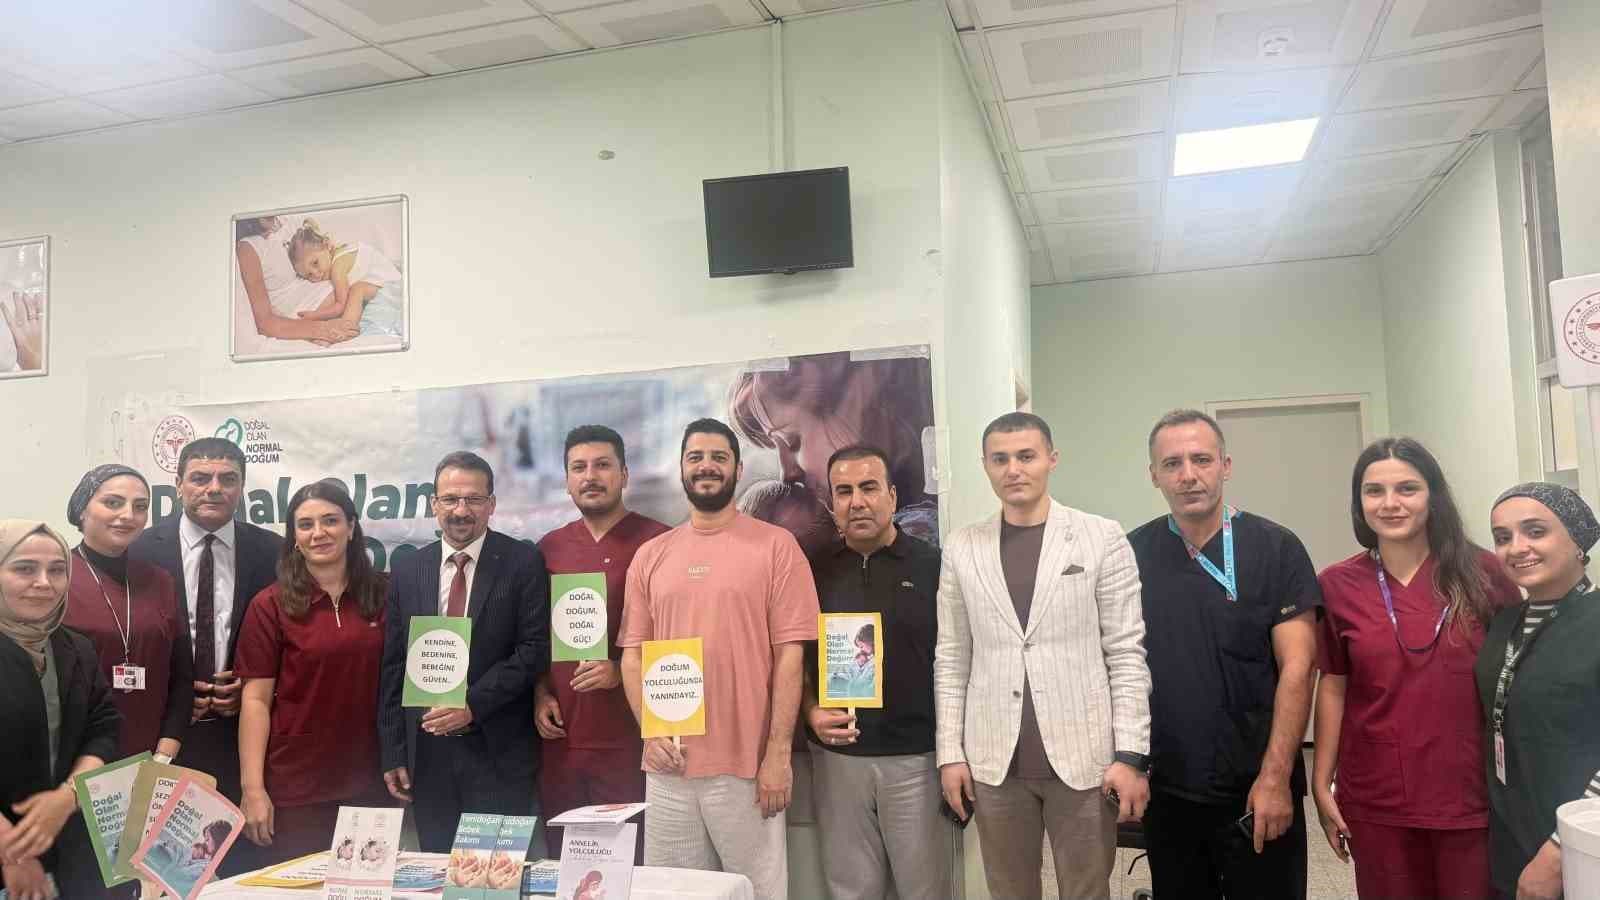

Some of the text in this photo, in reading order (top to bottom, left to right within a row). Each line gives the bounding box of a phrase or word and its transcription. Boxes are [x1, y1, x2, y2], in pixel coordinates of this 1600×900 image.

[246, 431, 267, 441] OLAN
[246, 442, 283, 453] NORMAL
[243, 452, 280, 464] DOĞUM
[569, 592, 594, 601] DOĞAL
[569, 620, 594, 629] DOĞAL
[573, 634, 591, 644] GÜÇ!
[660, 662, 690, 671] DOĞUM
[644, 676, 702, 686] YOLCULUĞUNDA
[92, 791, 122, 808] Doğal
[95, 803, 120, 816] Olan
